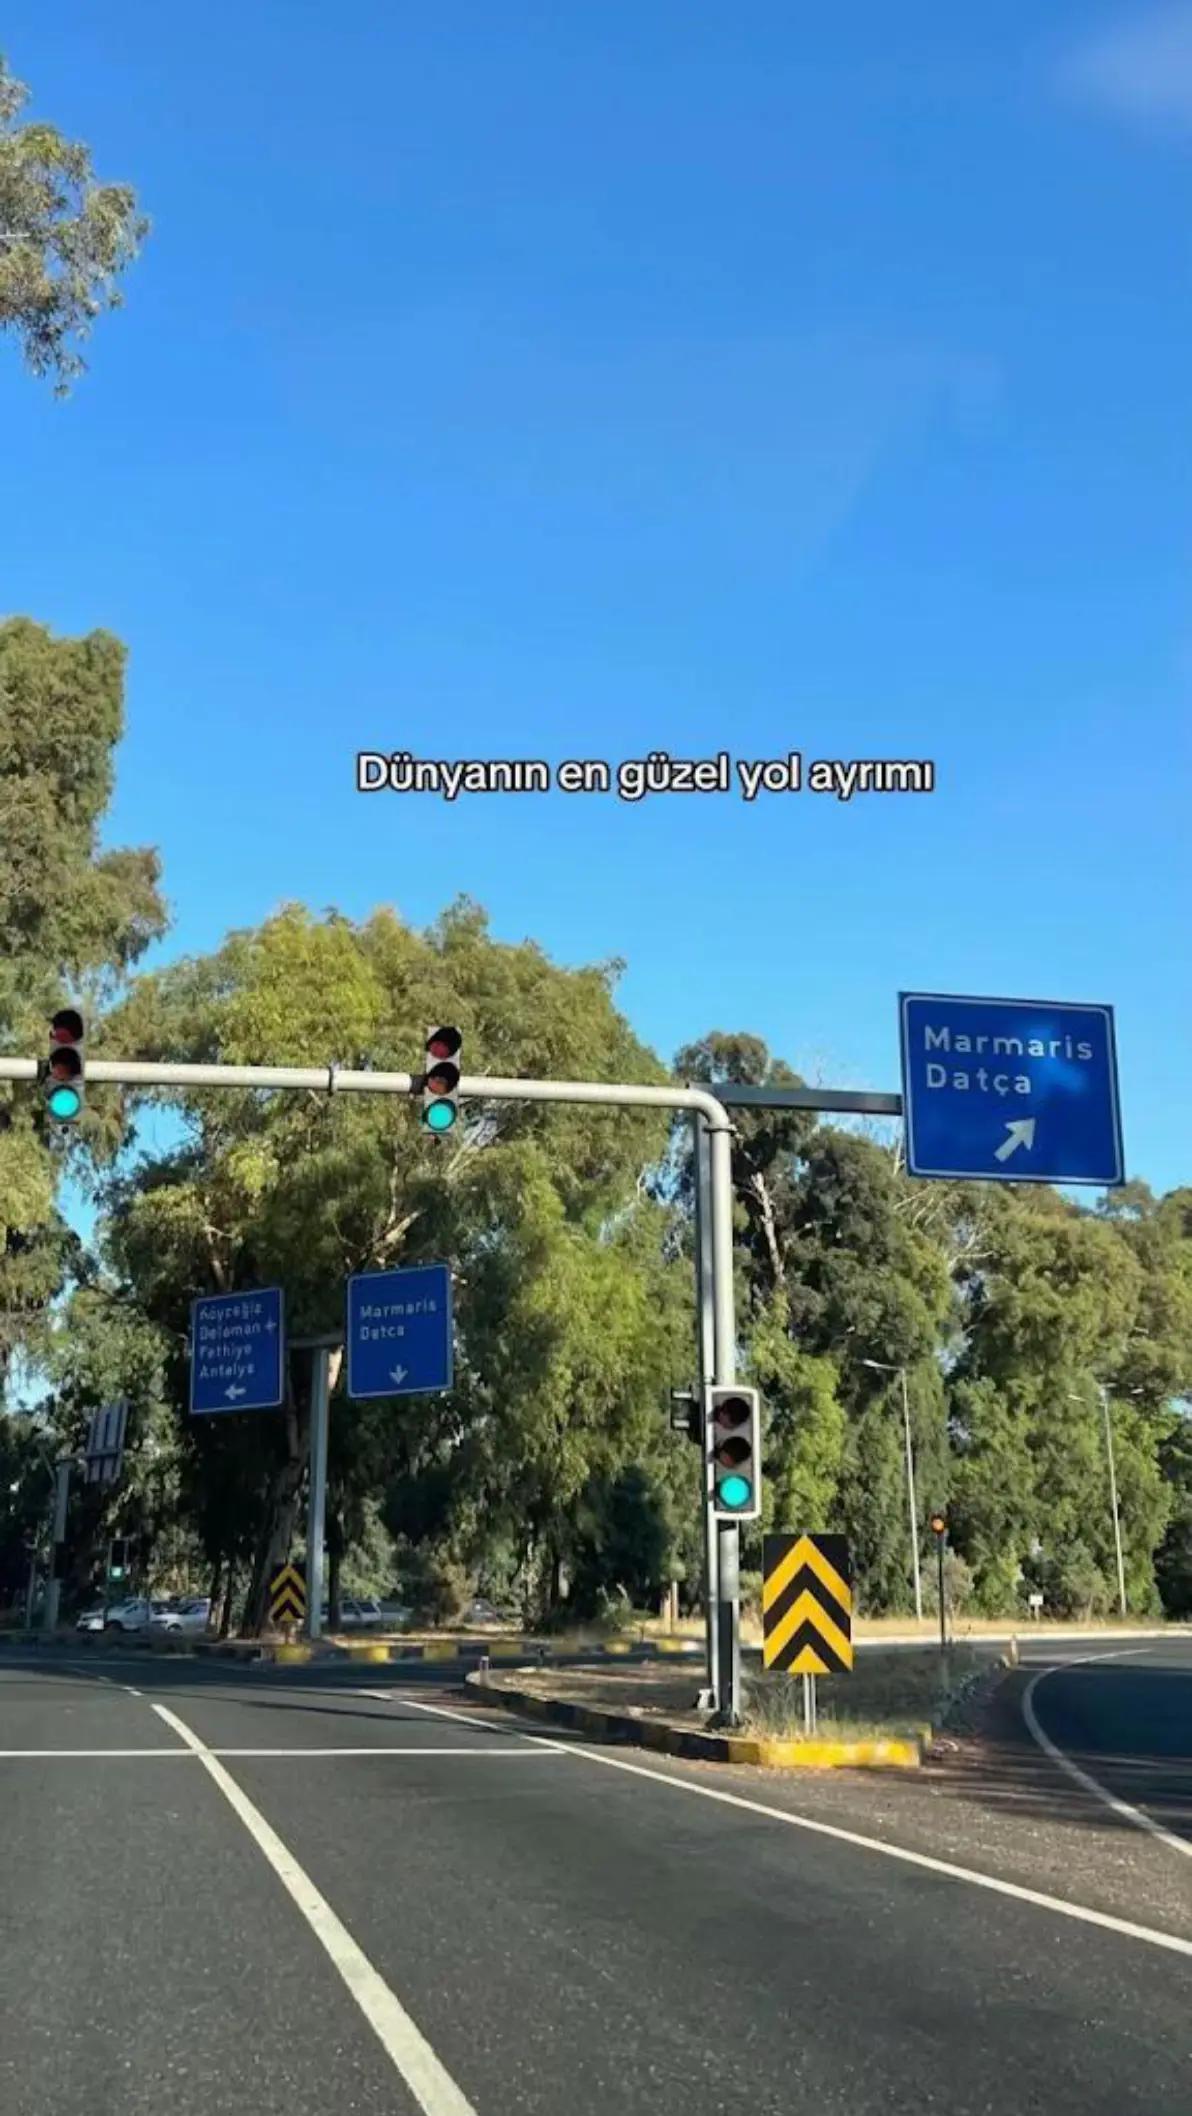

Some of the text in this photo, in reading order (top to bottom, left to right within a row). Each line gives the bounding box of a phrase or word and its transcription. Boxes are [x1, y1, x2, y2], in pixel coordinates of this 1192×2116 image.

[924, 1025, 1093, 1060] Marmaris
[926, 1063, 1032, 1096] Datça
[360, 1296, 437, 1319] Marmaris
